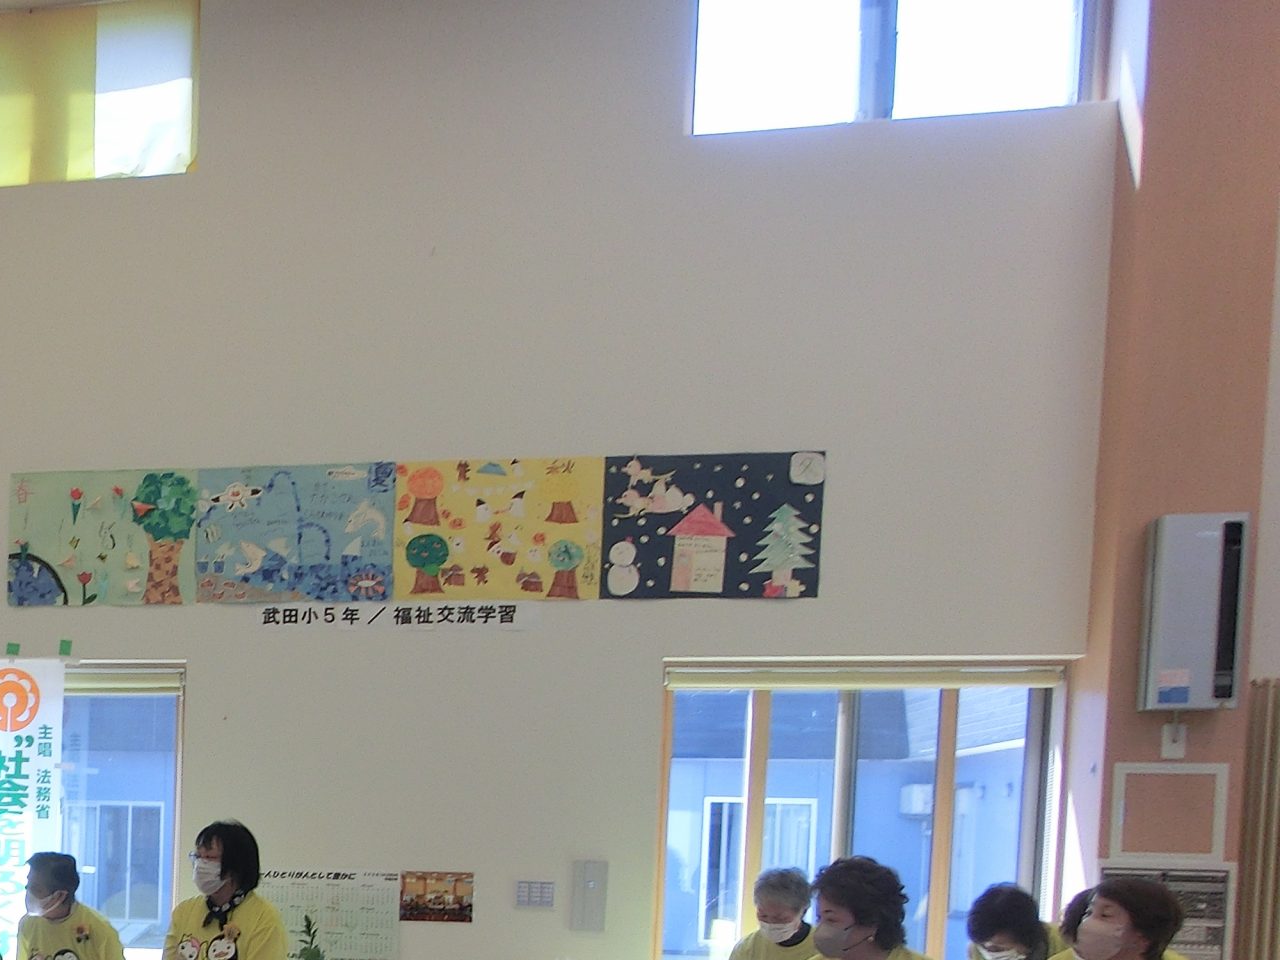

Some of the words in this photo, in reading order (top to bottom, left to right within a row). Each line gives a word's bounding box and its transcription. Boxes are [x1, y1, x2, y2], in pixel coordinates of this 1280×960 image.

[370, 462, 396, 493] 夏
[262, 606, 360, 625] 武田小5年
[393, 604, 517, 625] 福祉交流学習
[37, 724, 54, 758] 主唱
[35, 768, 52, 820] 法務省
